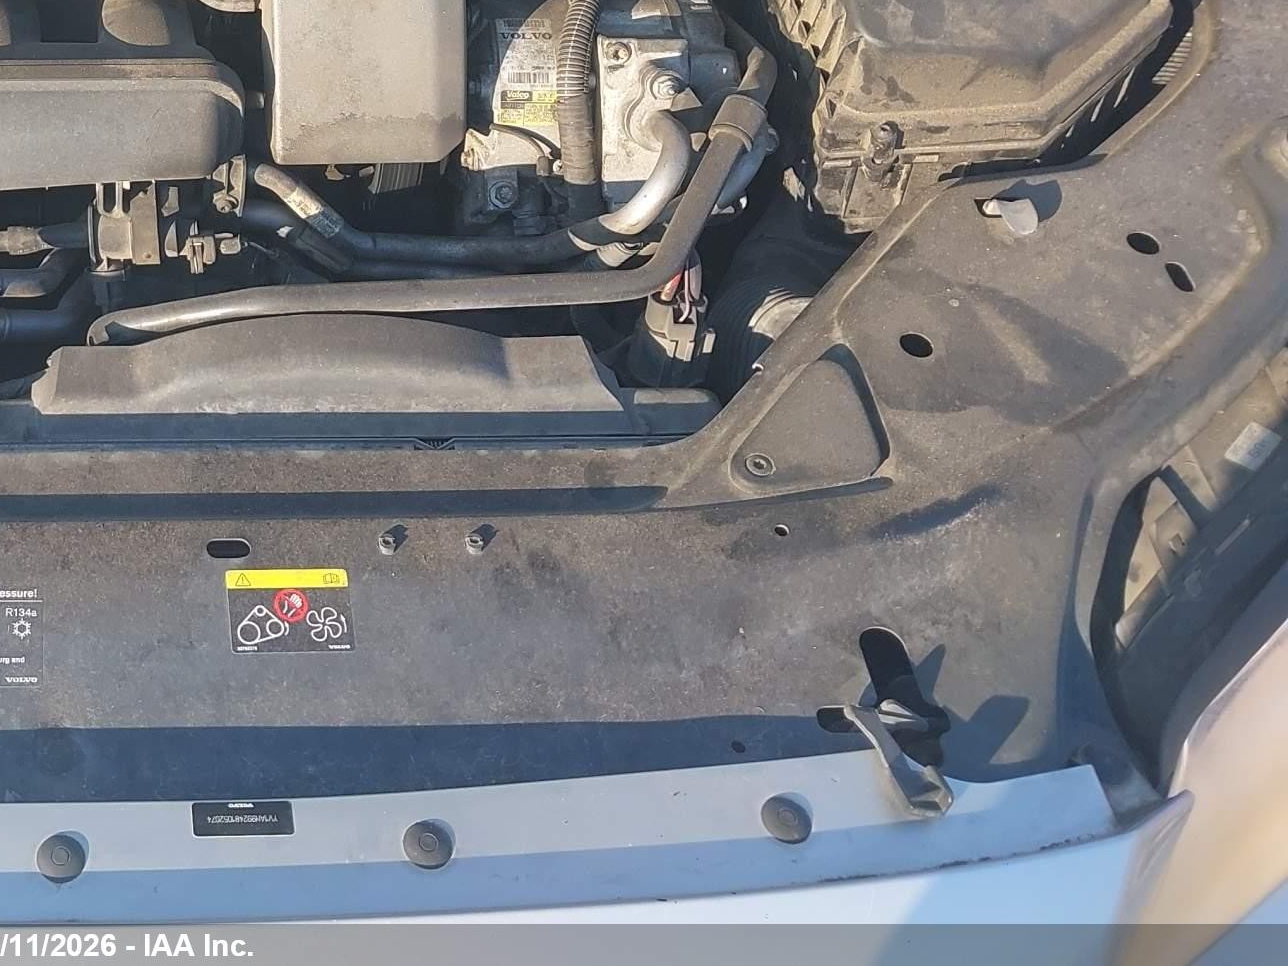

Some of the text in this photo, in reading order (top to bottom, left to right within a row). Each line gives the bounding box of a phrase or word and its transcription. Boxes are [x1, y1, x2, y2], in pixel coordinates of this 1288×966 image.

[499, 32, 553, 40] VOLVO
[506, 90, 530, 99] Valeo
[5, 608, 37, 617] R134a
